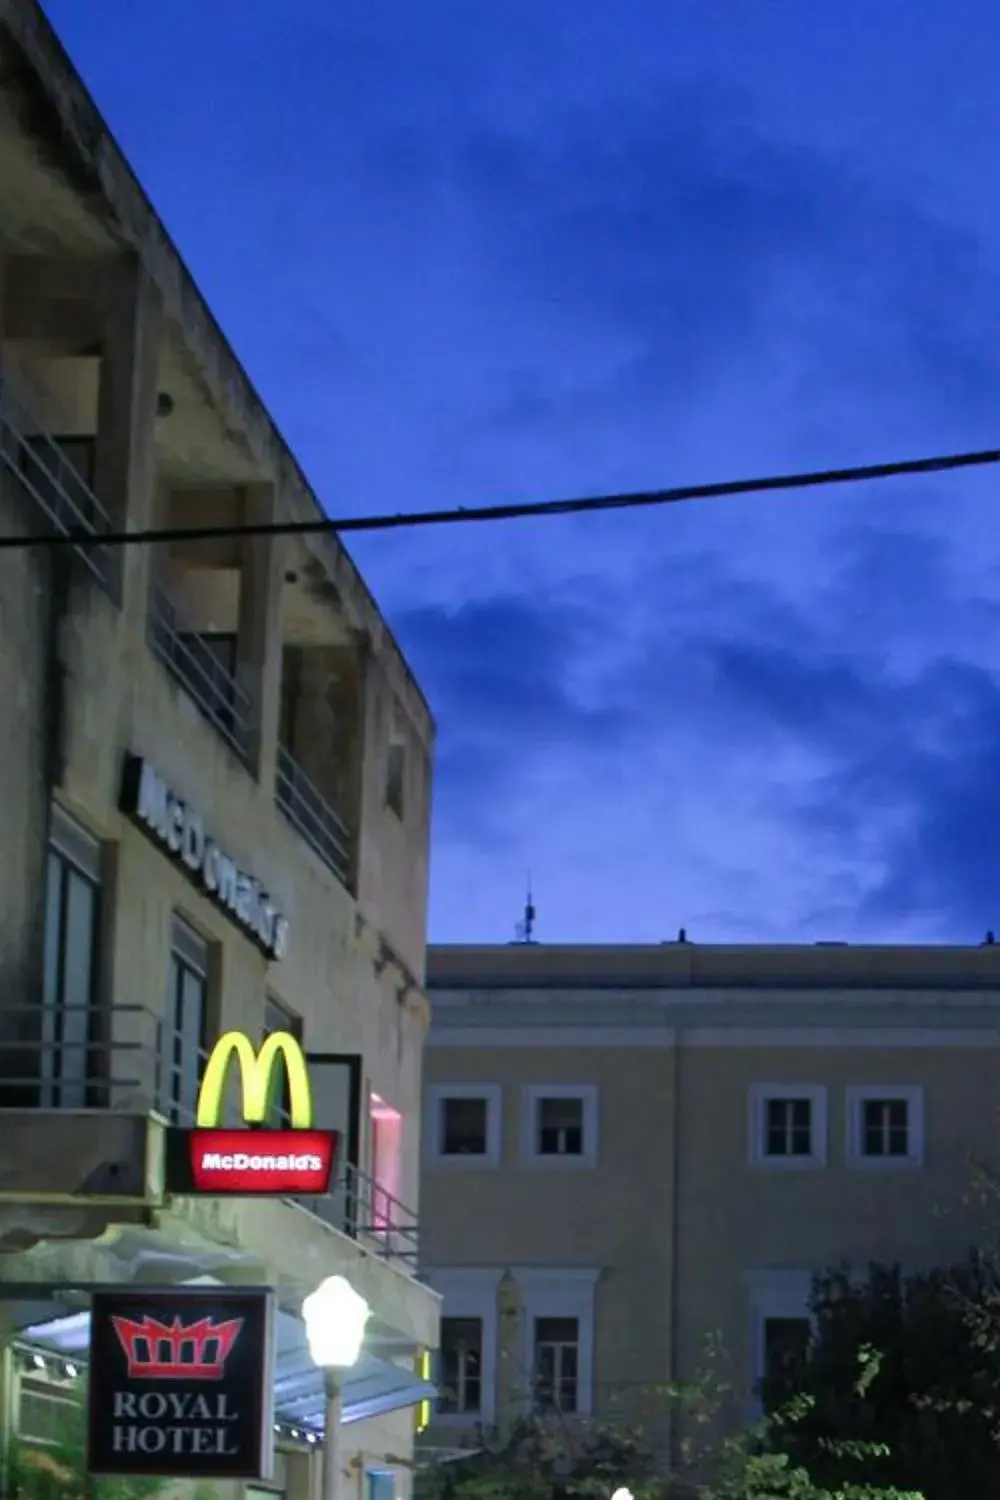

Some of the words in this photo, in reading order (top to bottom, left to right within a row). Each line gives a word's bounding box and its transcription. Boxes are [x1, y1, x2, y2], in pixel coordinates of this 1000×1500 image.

[202, 1153, 322, 1171] McDonald's
[112, 1391, 239, 1420] ROYAL
[112, 1426, 238, 1454] HOTEL
